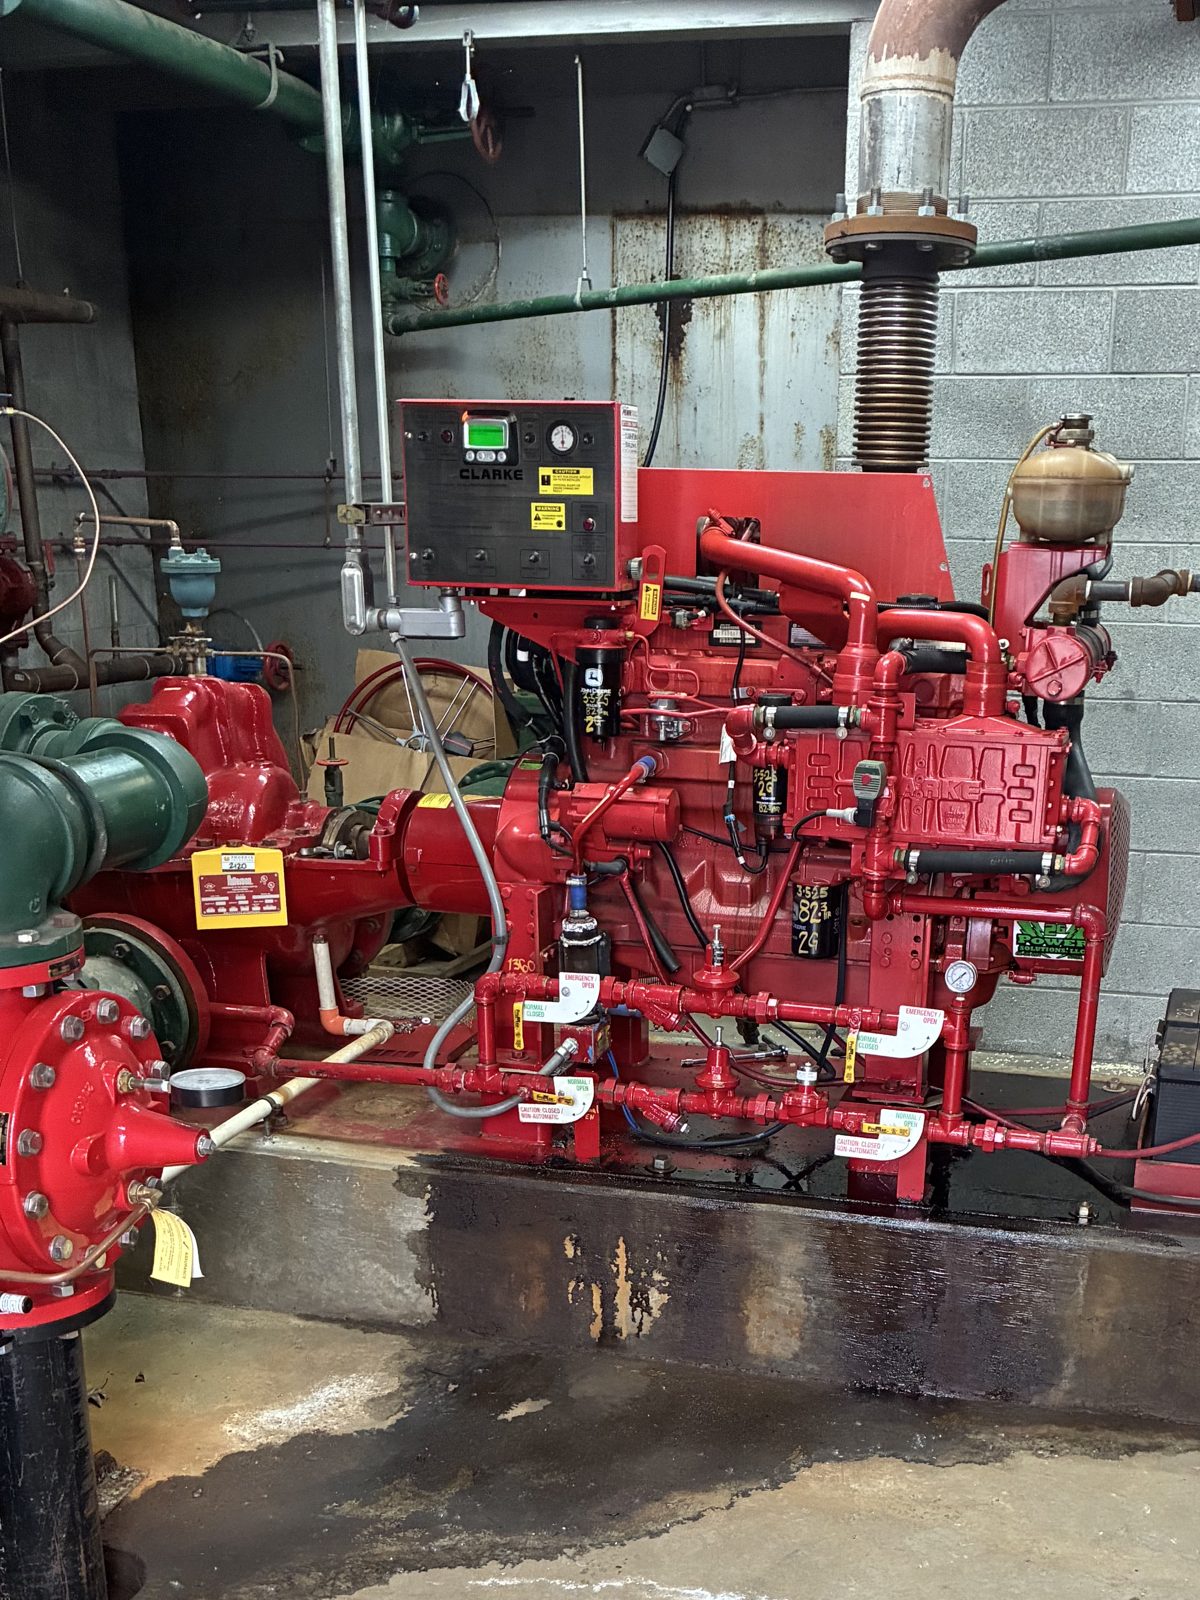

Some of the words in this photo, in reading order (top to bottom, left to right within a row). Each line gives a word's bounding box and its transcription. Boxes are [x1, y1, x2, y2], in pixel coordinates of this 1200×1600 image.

[459, 468, 524, 480] CLARKE
[798, 930, 819, 955] 2G
[564, 973, 594, 982] EMERGENCY
[581, 981, 595, 989] OPEN
[905, 1007, 938, 1018] EMERGENCY
[923, 1017, 937, 1025] OPEN
[858, 1043, 879, 1051] CLOSED
[895, 1112, 918, 1120] NORMAL
[903, 1120, 918, 1128] OPEN
[860, 1141, 880, 1149] CLOSED
